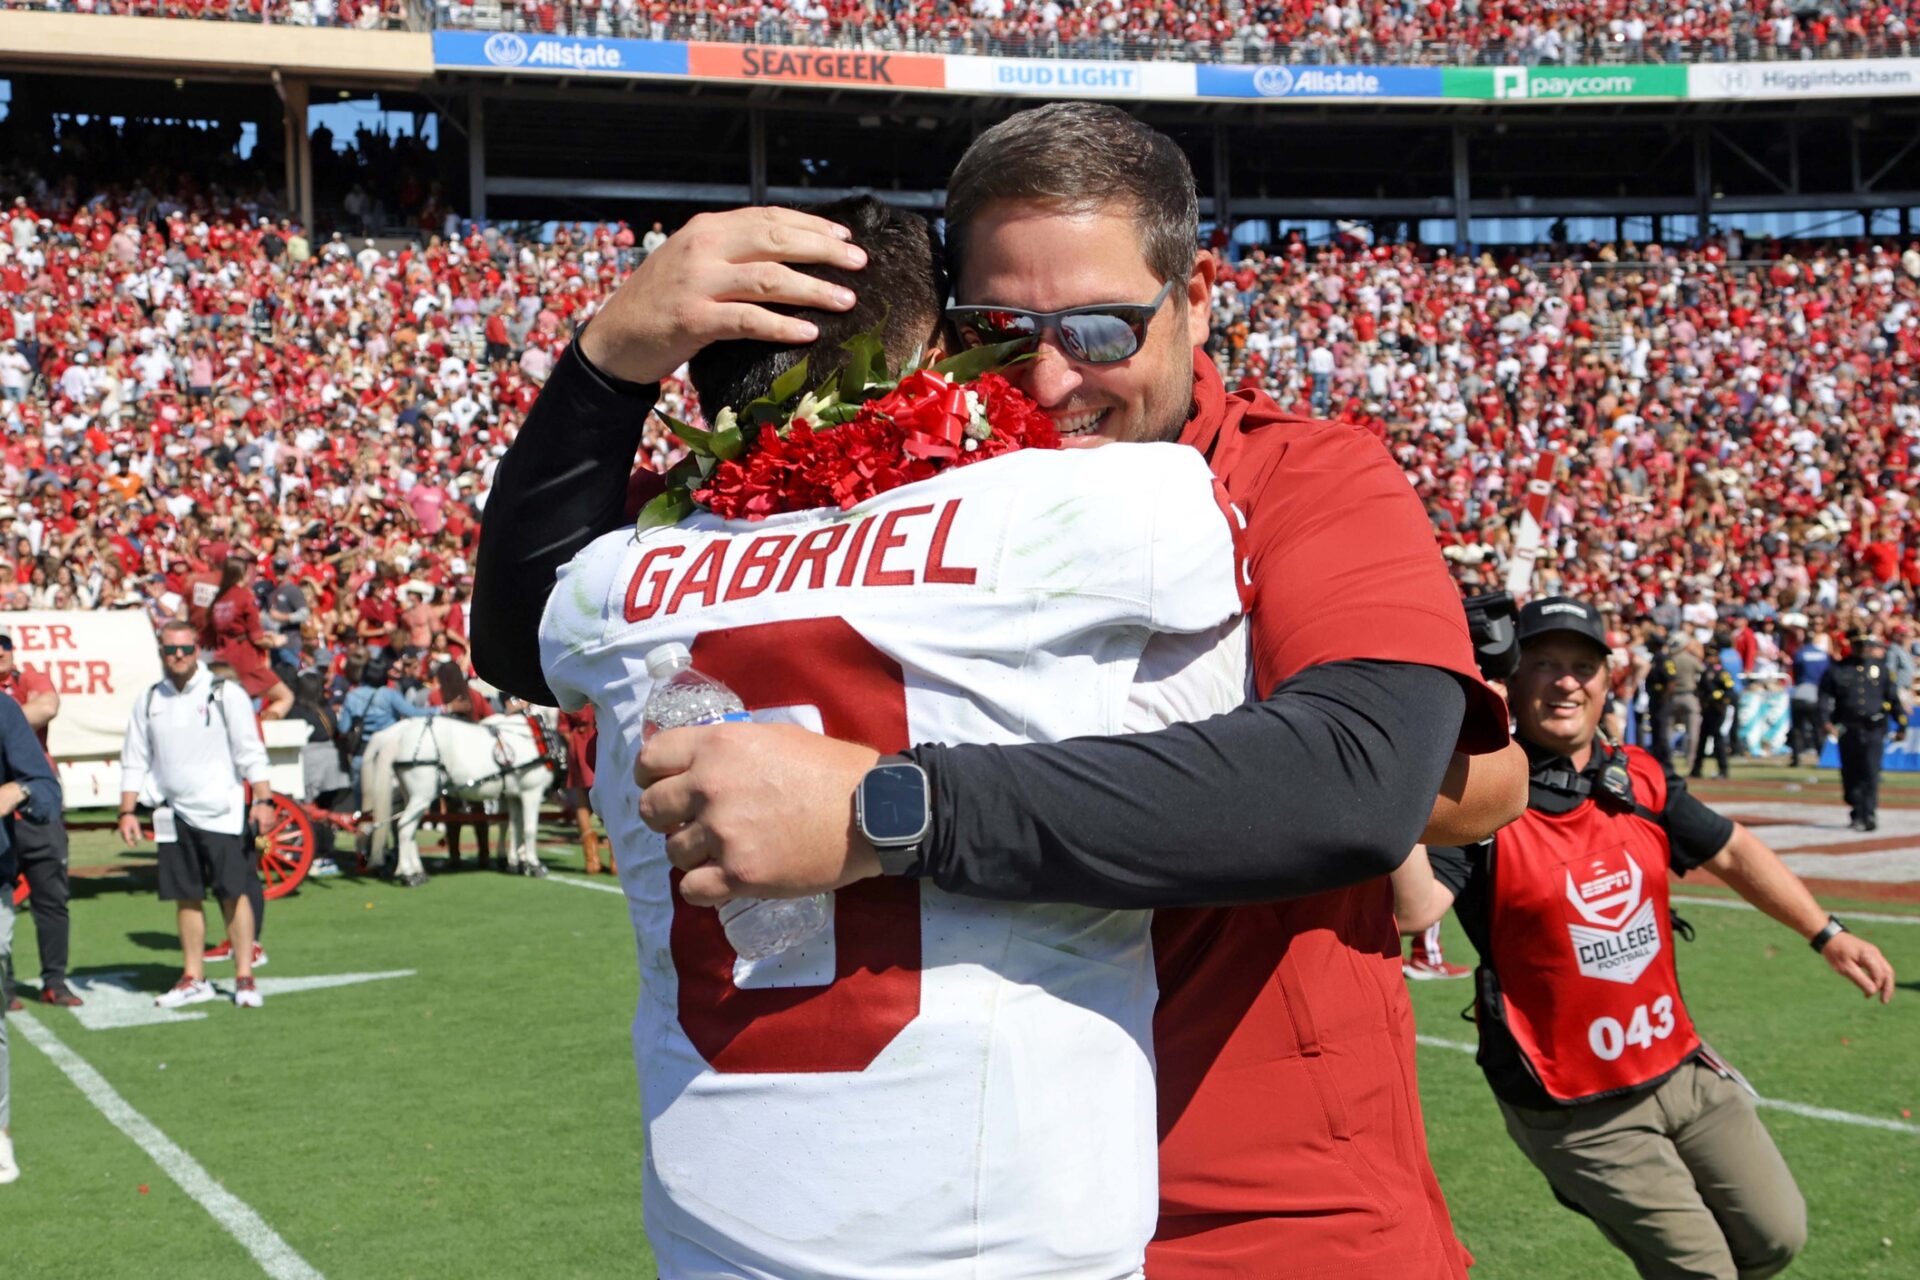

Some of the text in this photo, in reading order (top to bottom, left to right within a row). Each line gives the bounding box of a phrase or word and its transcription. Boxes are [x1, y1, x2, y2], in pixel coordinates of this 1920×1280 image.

[528, 41, 622, 70] Allstate
[742, 48, 893, 83] SEATGEEK
[997, 65, 1134, 87] BUD LIGHT
[1294, 70, 1380, 93] Allstate
[1531, 76, 1633, 98] paycom
[1763, 69, 1911, 90] Higginbotham
[623, 498, 978, 624] GABRIEL
[5, 625, 77, 650] ER
[1580, 869, 1631, 899] ESPN
[1579, 923, 1658, 965] COLLEGE
[1599, 949, 1652, 971] FOOTBALL
[1588, 994, 1675, 1061] 043
